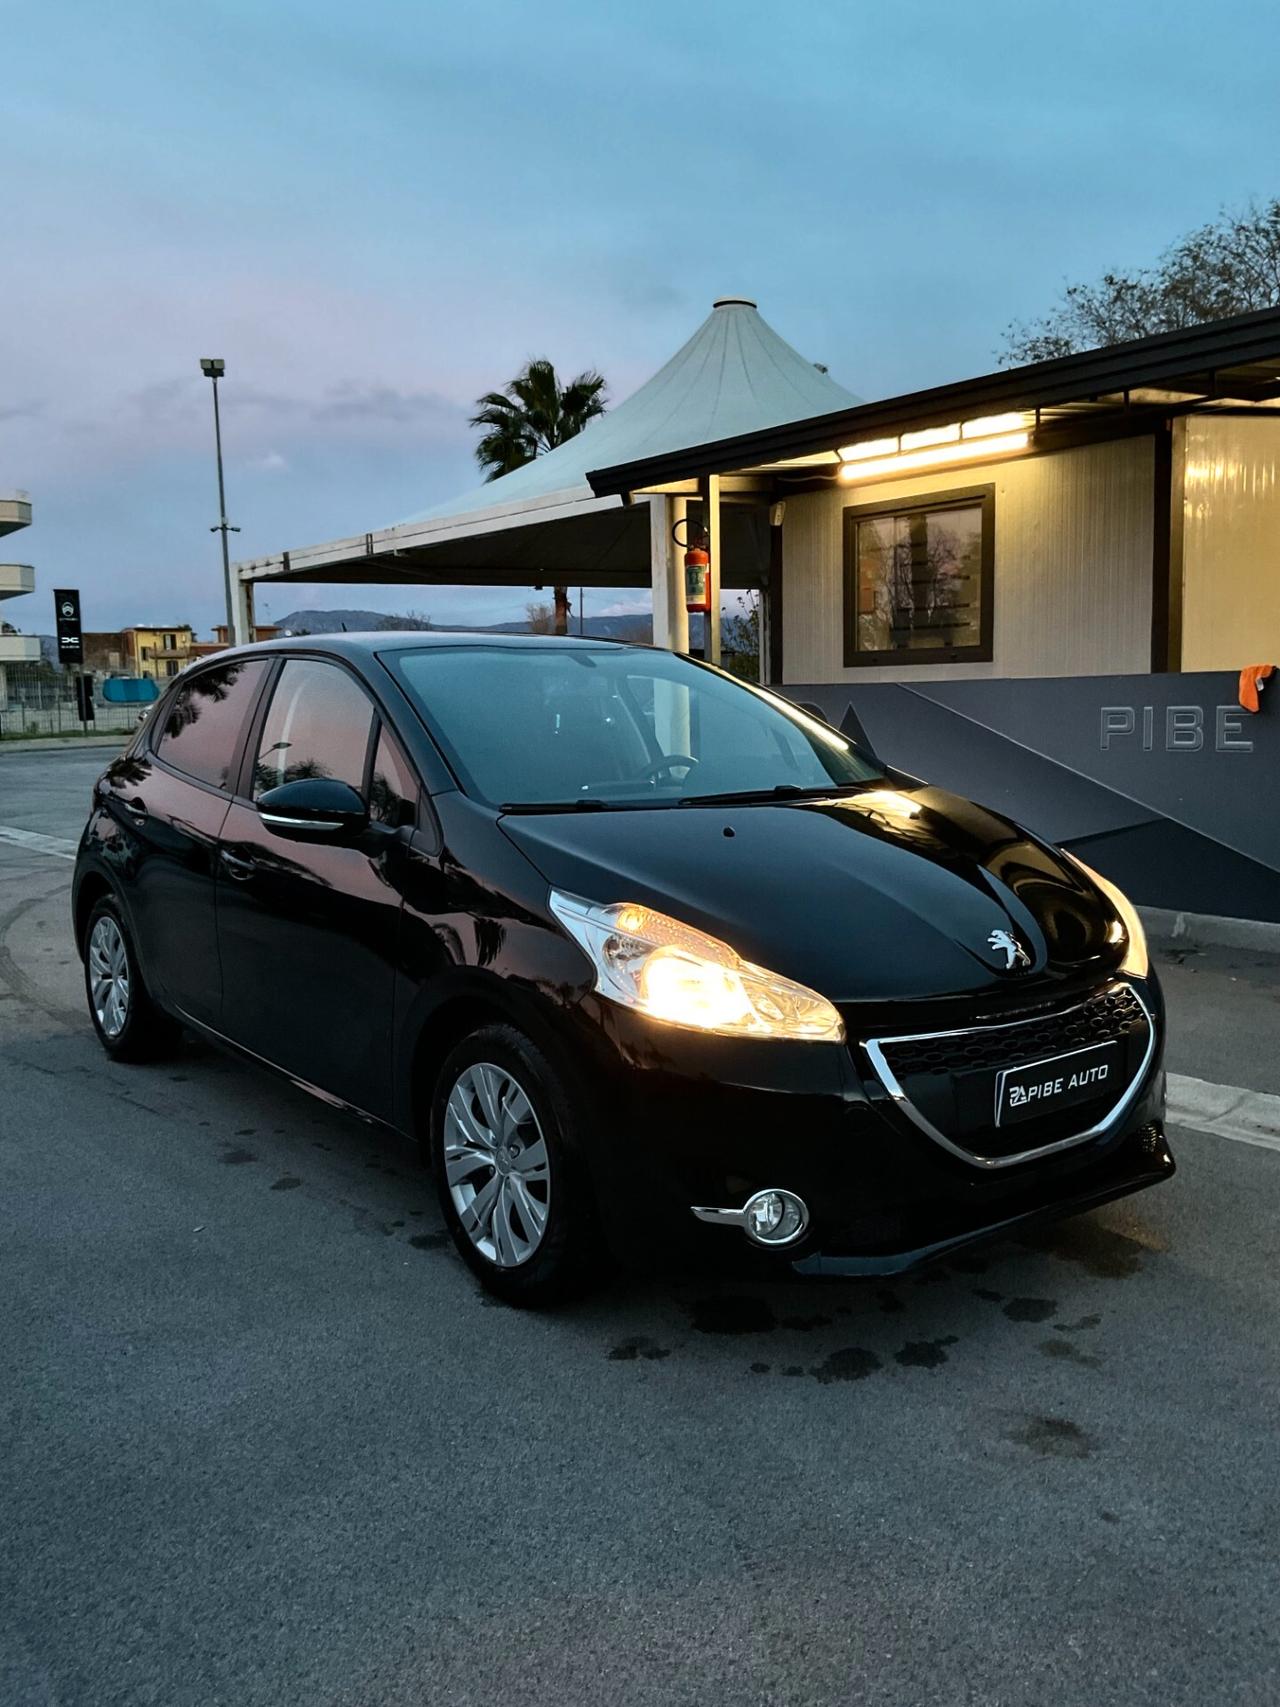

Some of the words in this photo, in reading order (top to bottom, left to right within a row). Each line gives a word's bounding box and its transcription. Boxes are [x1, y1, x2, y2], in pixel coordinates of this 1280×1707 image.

[1100, 705, 1254, 752] PIBE
[1028, 1078, 1064, 1101] PIBE
[1068, 1064, 1109, 1089] AUTO
